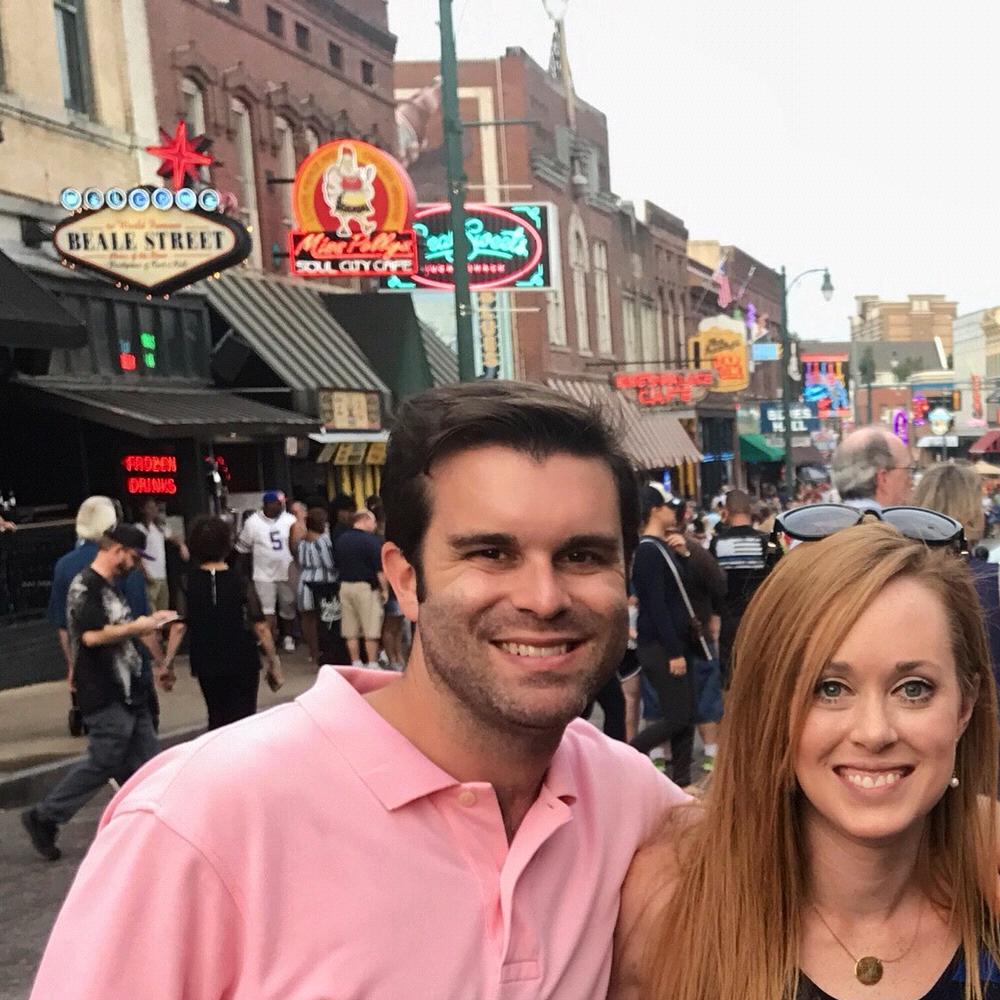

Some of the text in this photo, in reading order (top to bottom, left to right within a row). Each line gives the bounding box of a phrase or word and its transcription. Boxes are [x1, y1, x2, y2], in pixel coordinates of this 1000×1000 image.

[68, 230, 225, 251] BEALE STREET
[296, 260, 413, 272] SOUL CITY CAFE
[124, 456, 177, 472] FROZEN
[128, 477, 177, 494] DRINKS
[269, 531, 283, 551] 5
